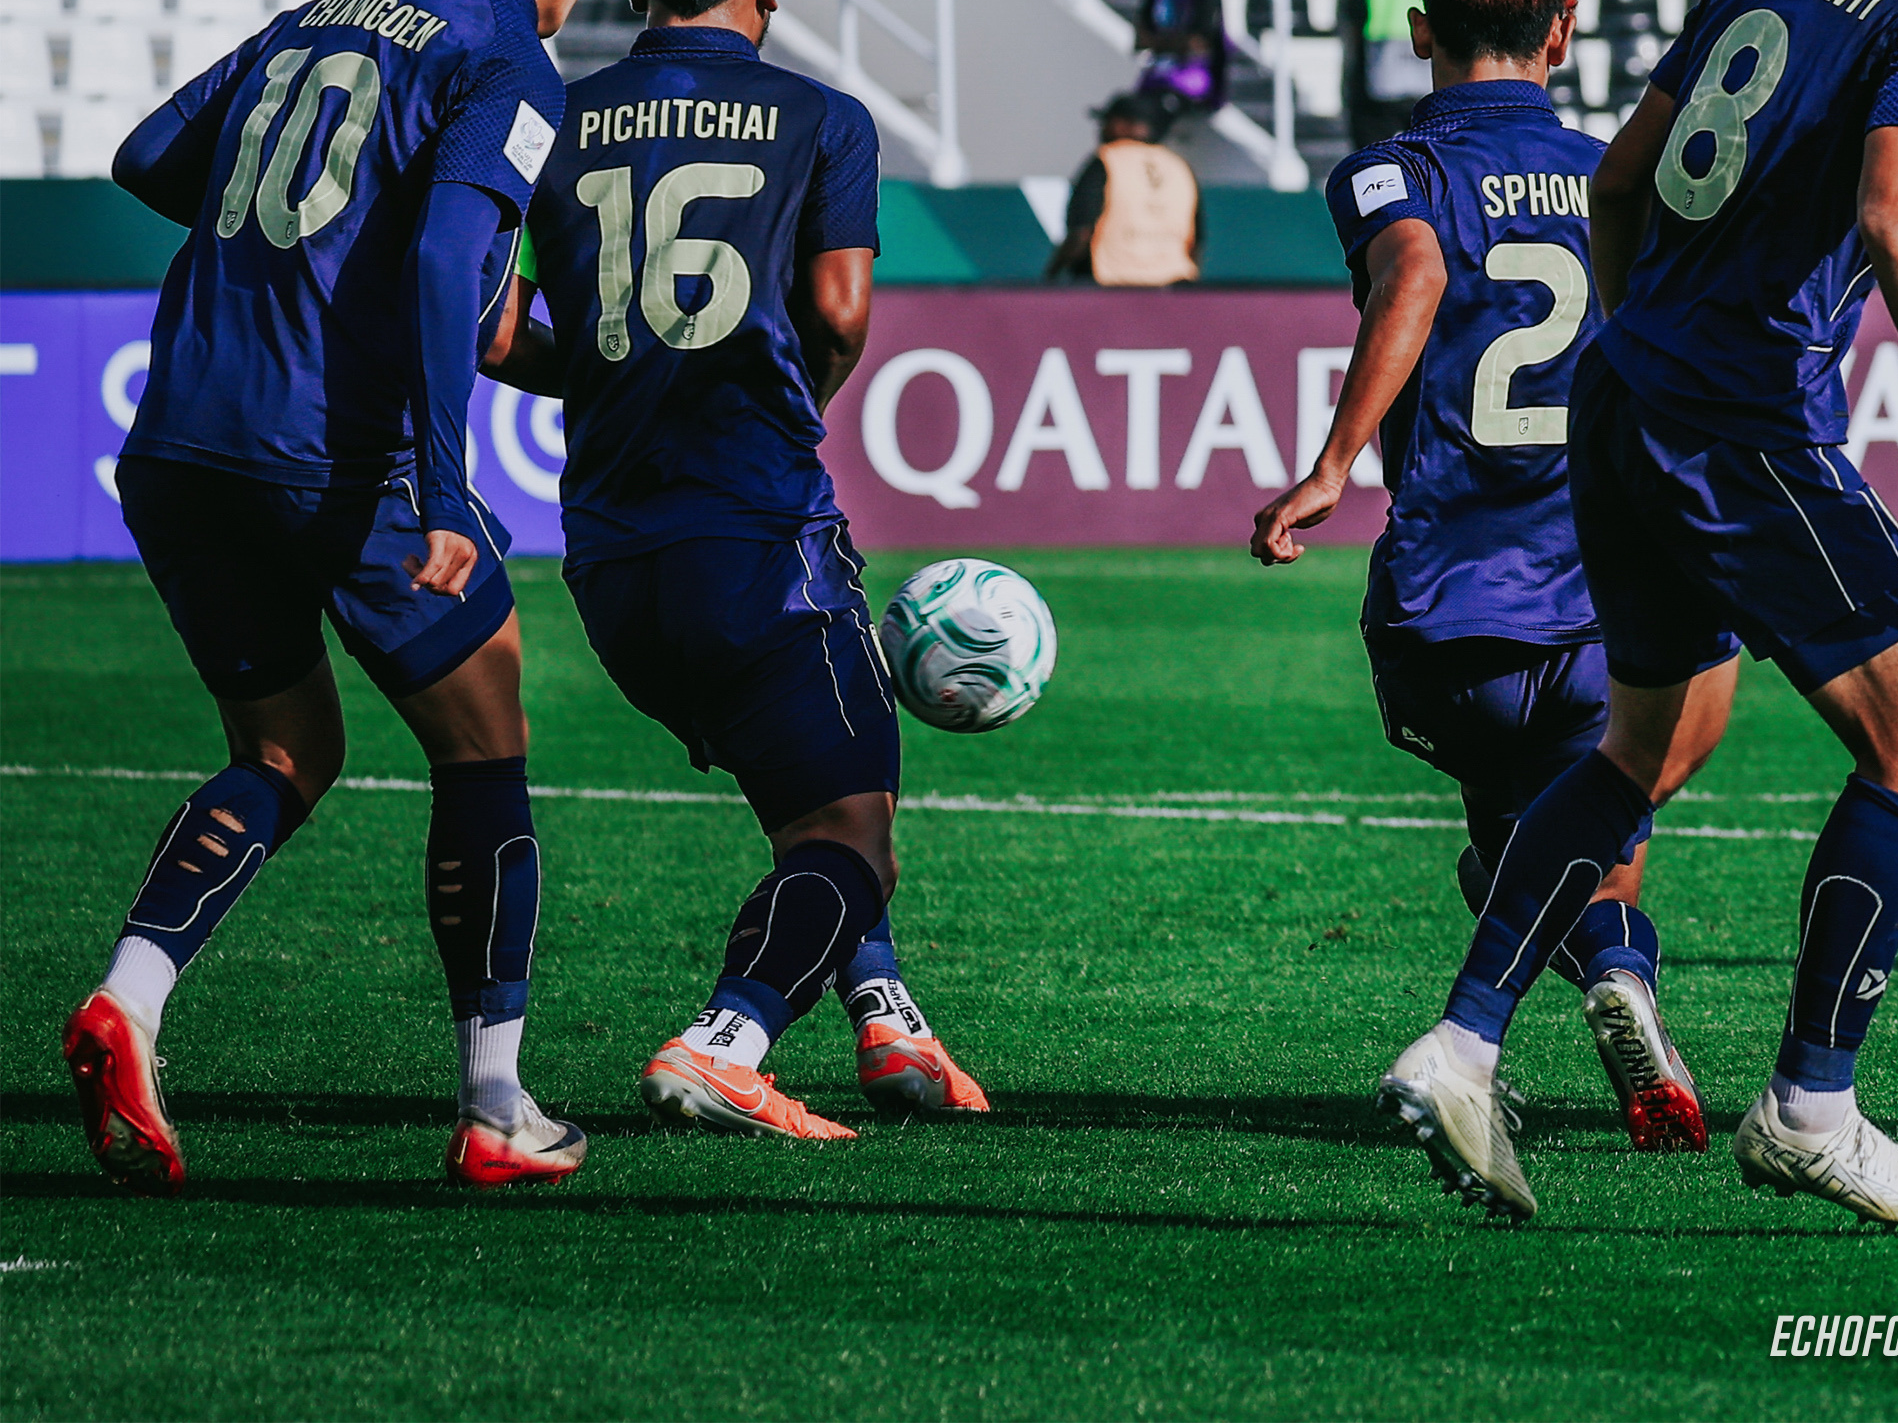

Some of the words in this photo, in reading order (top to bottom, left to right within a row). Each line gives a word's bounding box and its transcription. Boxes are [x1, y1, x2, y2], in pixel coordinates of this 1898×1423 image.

[216, 47, 381, 251] 10
[578, 98, 779, 150] PICHITCHAI
[1361, 178, 1398, 197] AFC
[1481, 173, 1591, 219] SPHON
[1653, 8, 1790, 221] 8
[576, 161, 766, 362] 16
[1470, 242, 1590, 447] 2
